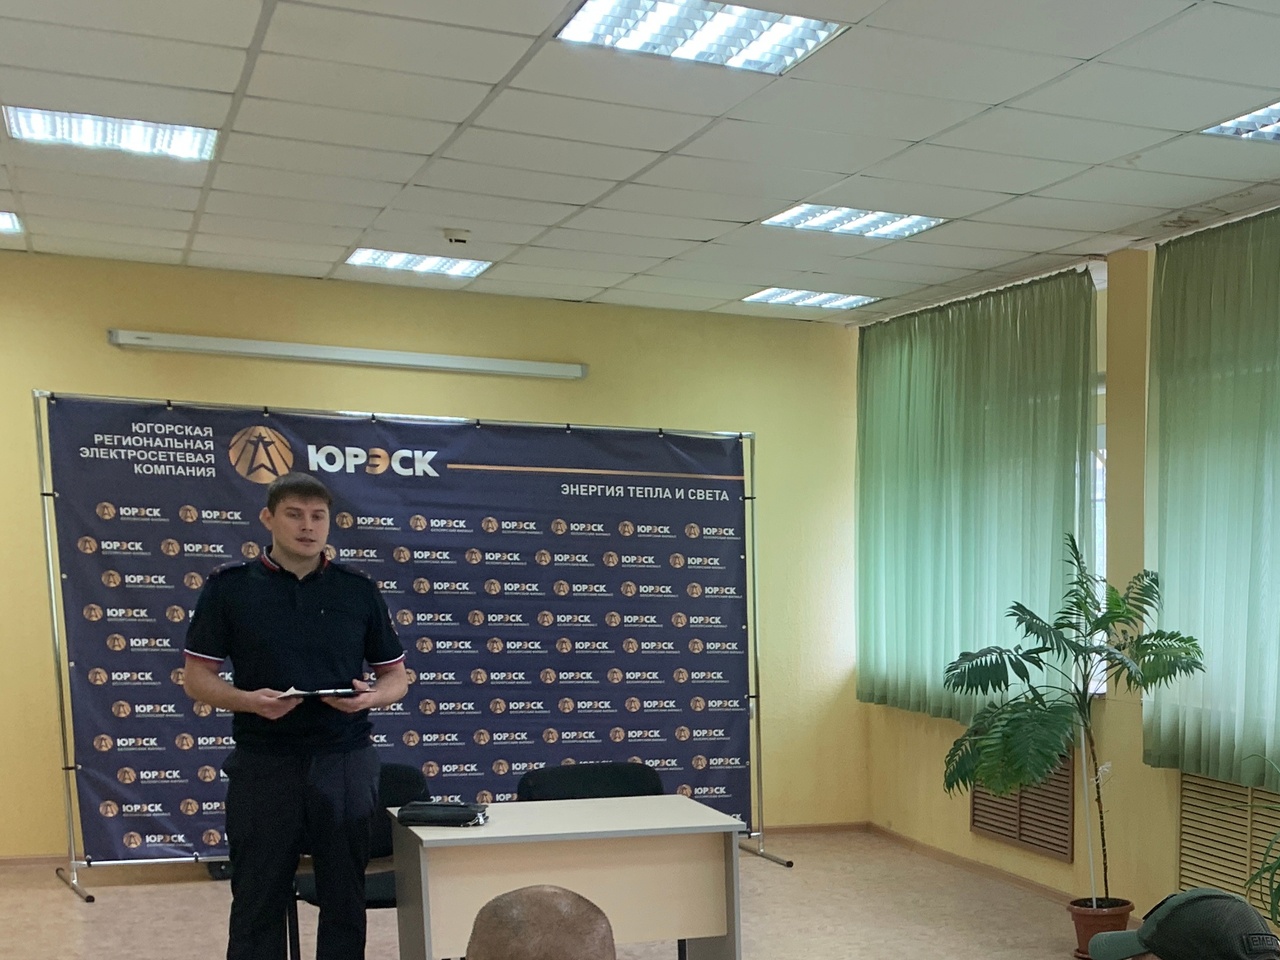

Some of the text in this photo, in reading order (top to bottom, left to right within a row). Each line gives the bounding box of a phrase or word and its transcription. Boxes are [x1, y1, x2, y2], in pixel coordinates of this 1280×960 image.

[131, 422, 213, 437] ЮГОРСКАЯ
[94, 434, 214, 450] РЕГИОНАЛЬНАЯ
[79, 447, 215, 464] ЭЛЕКТРОСЕТЕВАЯ
[307, 444, 440, 477] ЮРЭСК
[133, 463, 216, 477] КОМПАНИЯ
[560, 483, 730, 502] ЭНЕРГИЯ ТЕПЛА И СВЕТА
[119, 506, 161, 517] ЮРЭСК
[202, 510, 241, 520] ЮРЭСК
[357, 516, 394, 526] ЮРЭСК
[430, 519, 466, 528] ЮРЭСК
[501, 521, 536, 530] ЮРЭСК
[570, 523, 604, 532] ЮРЭСК
[637, 525, 670, 534] ЮРЭСК
[703, 527, 735, 536] ЮРЭСК
[101, 541, 143, 551] ЮРЭСК
[184, 543, 224, 553] ЮРЭСК
[339, 548, 377, 558] ЮРЭСК
[413, 550, 450, 560] ЮРЭСК
[485, 552, 521, 561] ЮРЭСК
[554, 553, 588, 563] ЮРЭСК
[621, 555, 655, 564] ЮРЭСК
[687, 557, 720, 566] ЮРЭСК
[125, 574, 166, 584] ЮРЭСК
[377, 580, 397, 589] ЭСК
[433, 581, 469, 591] ЮРЭСК
[503, 582, 539, 592] ЮРЭСК
[572, 584, 606, 593] ЮРЭСК
[639, 585, 672, 594] ЮРЭСК
[704, 587, 737, 595] ЮРЭСК
[106, 608, 148, 618] ЮРЭСК
[416, 613, 453, 622] ЮРЭСК
[487, 613, 523, 622] ЮРЭСК
[556, 614, 591, 623] ЮРЭСК
[623, 615, 657, 624] ЮРЭСК
[689, 616, 722, 625] ЮРЭСК
[129, 638, 171, 647] ЮРЭСК
[435, 640, 472, 649] ЮРЭСК
[506, 641, 541, 650] ЮРЭСК
[574, 641, 609, 650] ЮРЭСК
[640, 641, 674, 650] ЮРЭСК
[706, 641, 739, 650] ЮРЭСК
[111, 671, 153, 681] ЮРЭСК
[419, 672, 456, 681] ЮРЭСК
[490, 671, 525, 680] ЮРЭСК
[559, 671, 593, 680] ЮРЭСК
[625, 671, 659, 680] ЮРЭСК
[691, 671, 723, 680] ЮРЭСК
[369, 702, 404, 711] ЭСК
[439, 702, 475, 711] ЮРЭСК
[509, 701, 544, 710] ЮРЭСК
[576, 700, 611, 709] ЮРЭСК
[643, 700, 676, 708] ЮРЭСК
[708, 699, 740, 708] ЮРЭСК
[134, 704, 176, 713] ЮРЭСК
[422, 733, 459, 742] ЮРЭСК
[492, 732, 528, 741] ЮРЭСК
[561, 730, 596, 739] ЮРЭСК
[627, 729, 661, 738] ЮРЭСК
[692, 729, 725, 738] ЮРЭСК
[117, 737, 158, 747] ЮРЭСК
[709, 757, 741, 766] ЮРЭСК
[442, 763, 478, 773] ЮРЭСК
[140, 769, 180, 780] ЮРЭСК
[694, 786, 726, 795] ЮРЭСК
[495, 793, 518, 802] ЮРЭ
[122, 803, 163, 813] ЮРЭСК
[202, 801, 226, 811] ЮРЭ
[145, 834, 186, 844] ЮРЭСК
